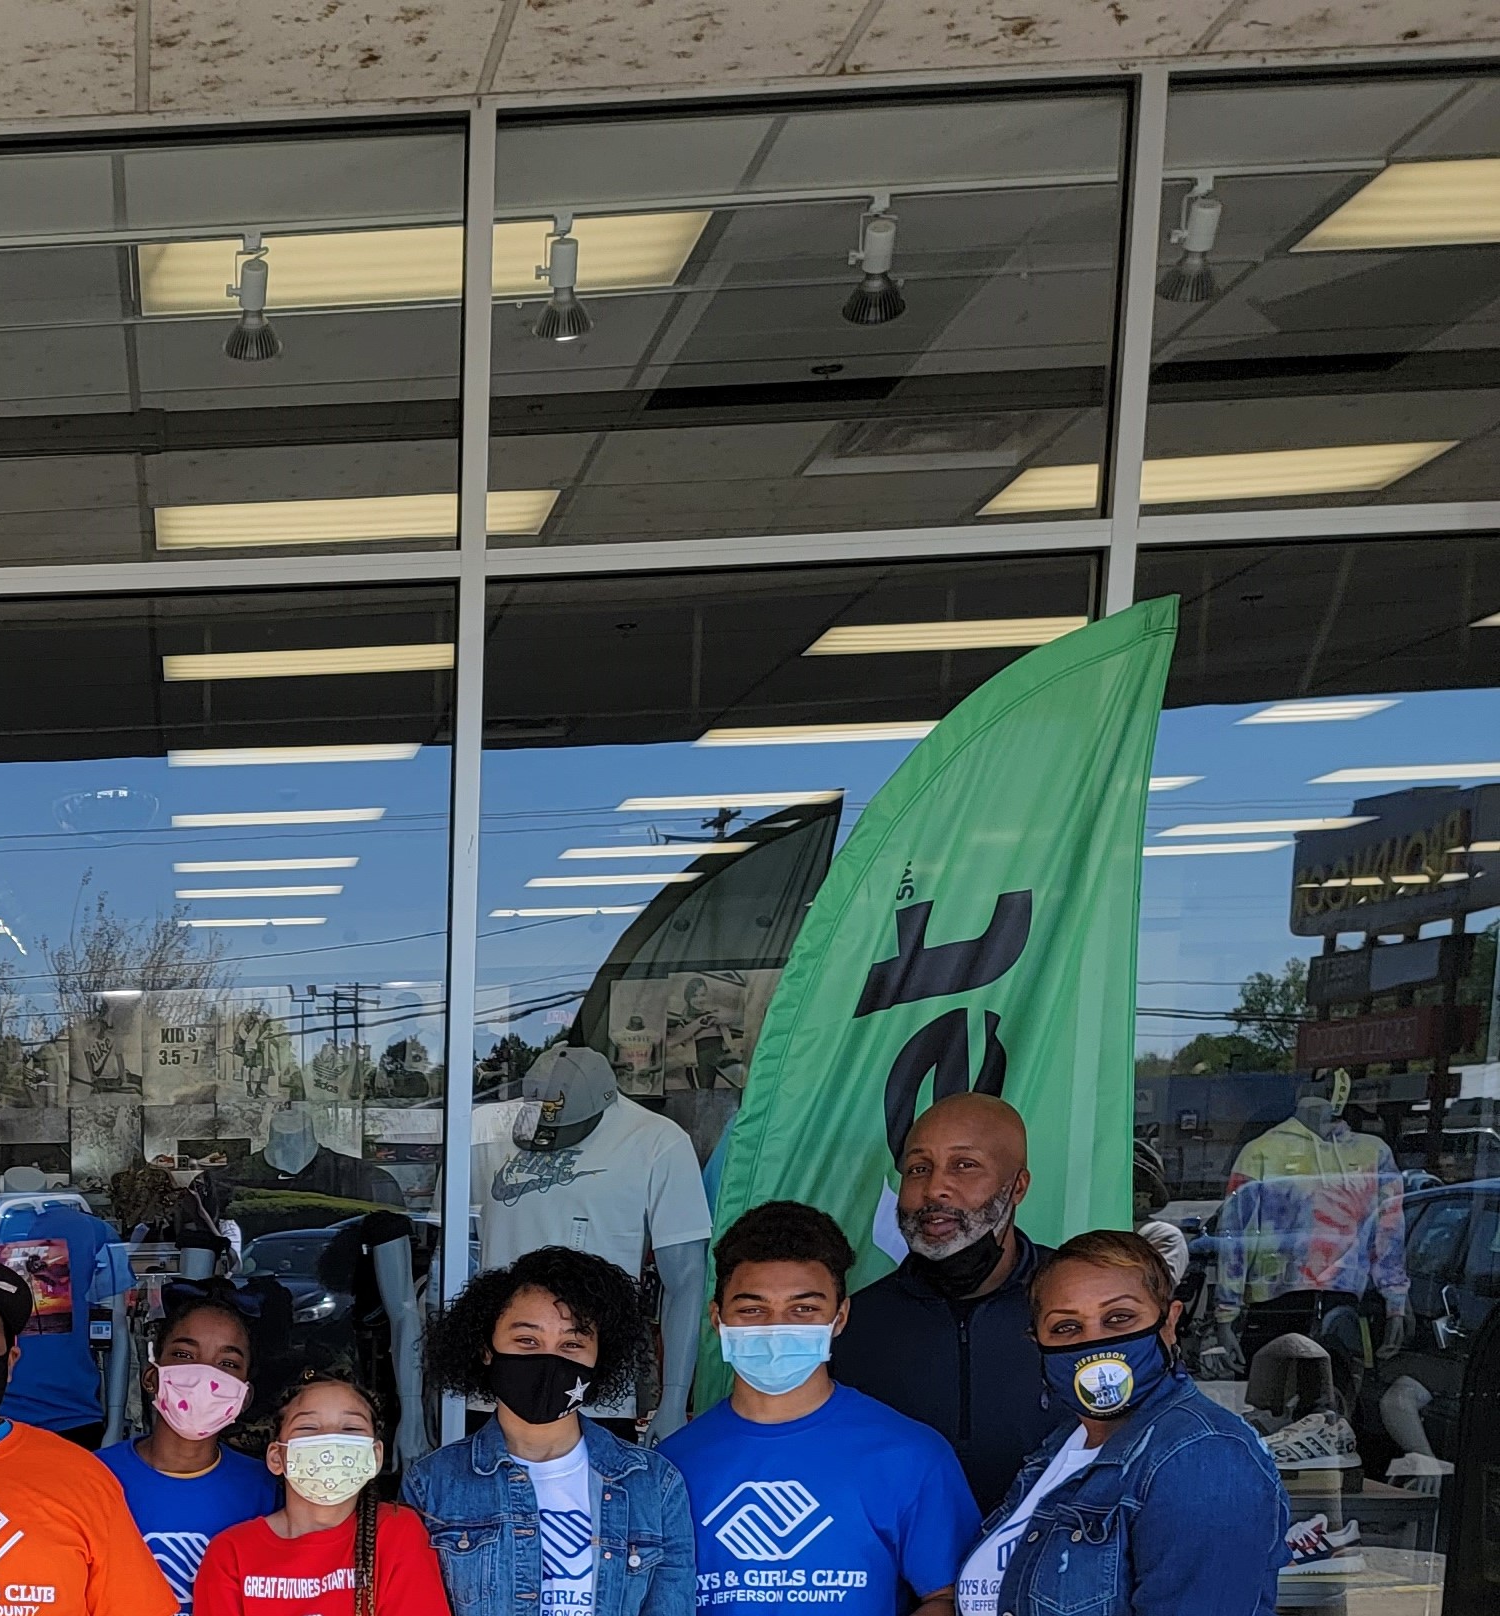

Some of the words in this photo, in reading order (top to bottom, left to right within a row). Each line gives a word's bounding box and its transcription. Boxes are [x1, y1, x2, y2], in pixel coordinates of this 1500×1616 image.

[158, 1050, 181, 1066] 3.5
[1074, 1352, 1127, 1371] JEFFERSON
[243, 1575, 278, 1599] GREAT
[277, 1577, 321, 1599] FUTURES
[724, 1570, 740, 1587] &
[743, 1569, 806, 1587] GIRLS
[811, 1569, 868, 1588] CLUB
[980, 1579, 989, 1596] &
[4, 1584, 55, 1603] CLUB
[541, 1589, 593, 1607] GIRLS
[711, 1589, 784, 1605] JEFFERSON
[787, 1589, 847, 1603] COUNTY
